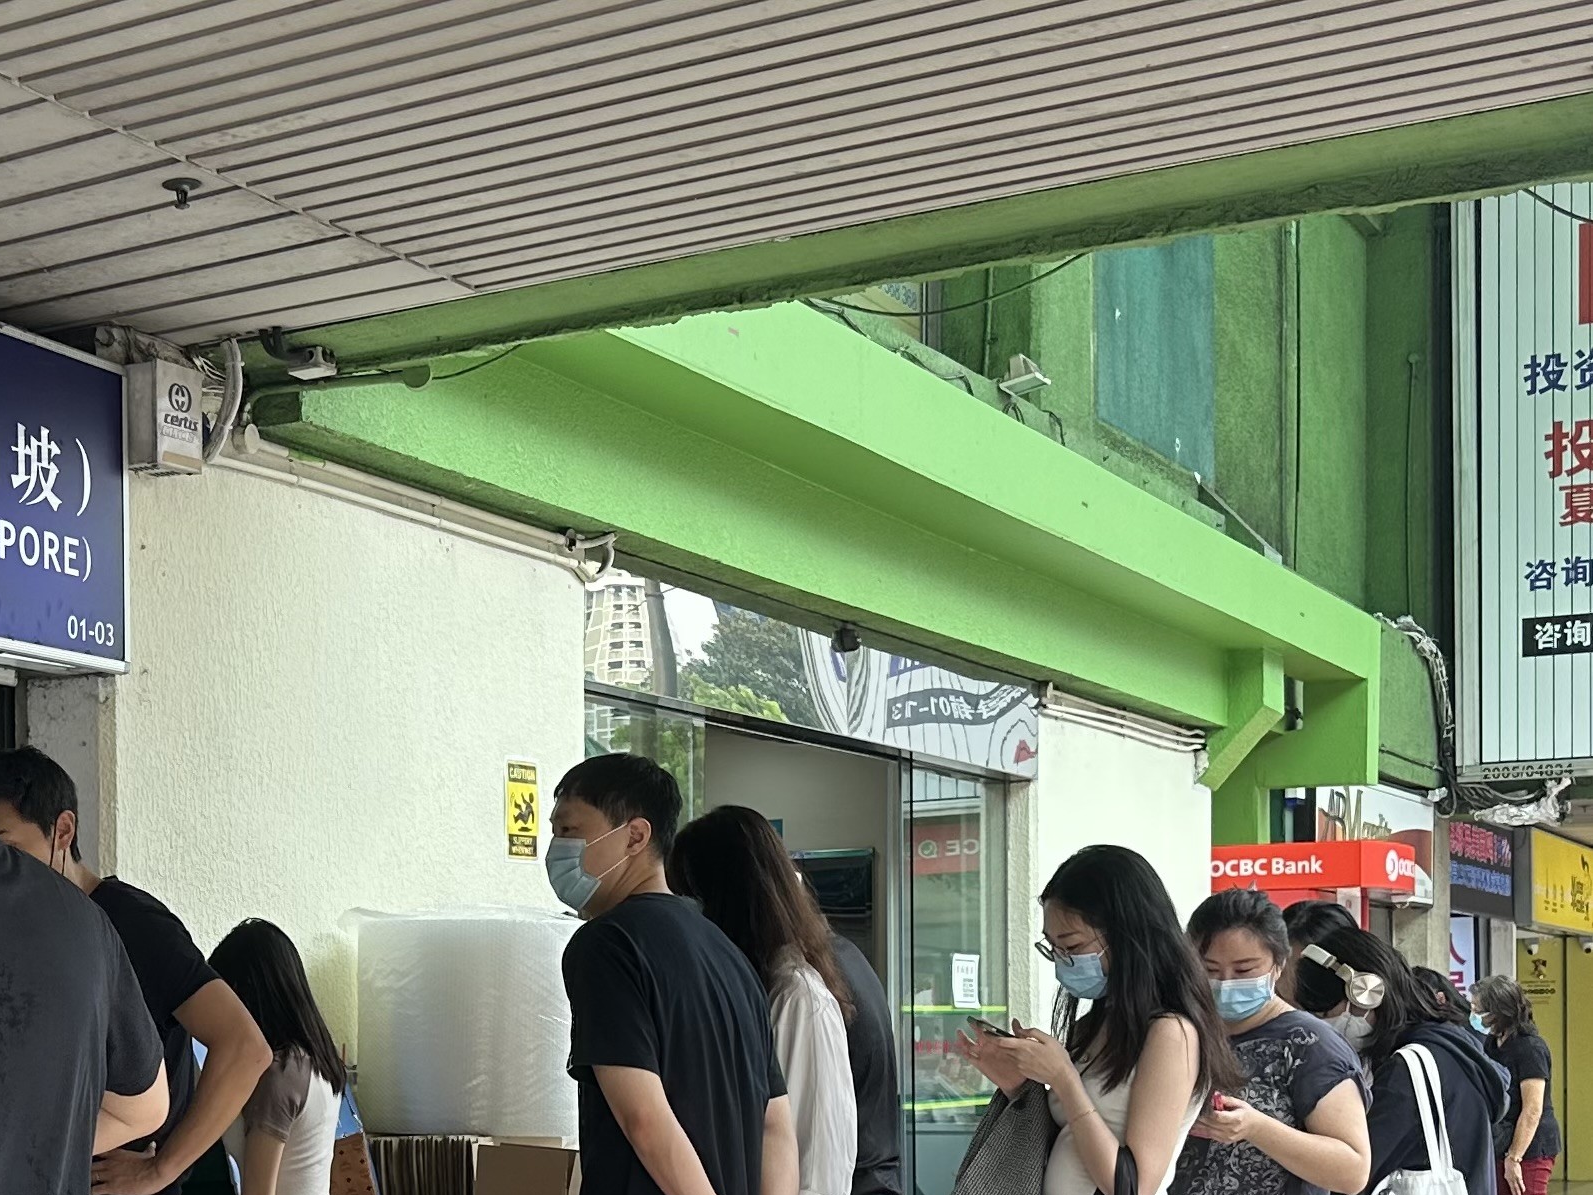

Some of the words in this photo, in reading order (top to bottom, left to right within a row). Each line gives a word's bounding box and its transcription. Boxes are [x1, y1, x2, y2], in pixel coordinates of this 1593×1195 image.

[66, 615, 115, 648] 01-03
[1210, 857, 1268, 878] OCBC
[1271, 854, 1323, 876] Bank
